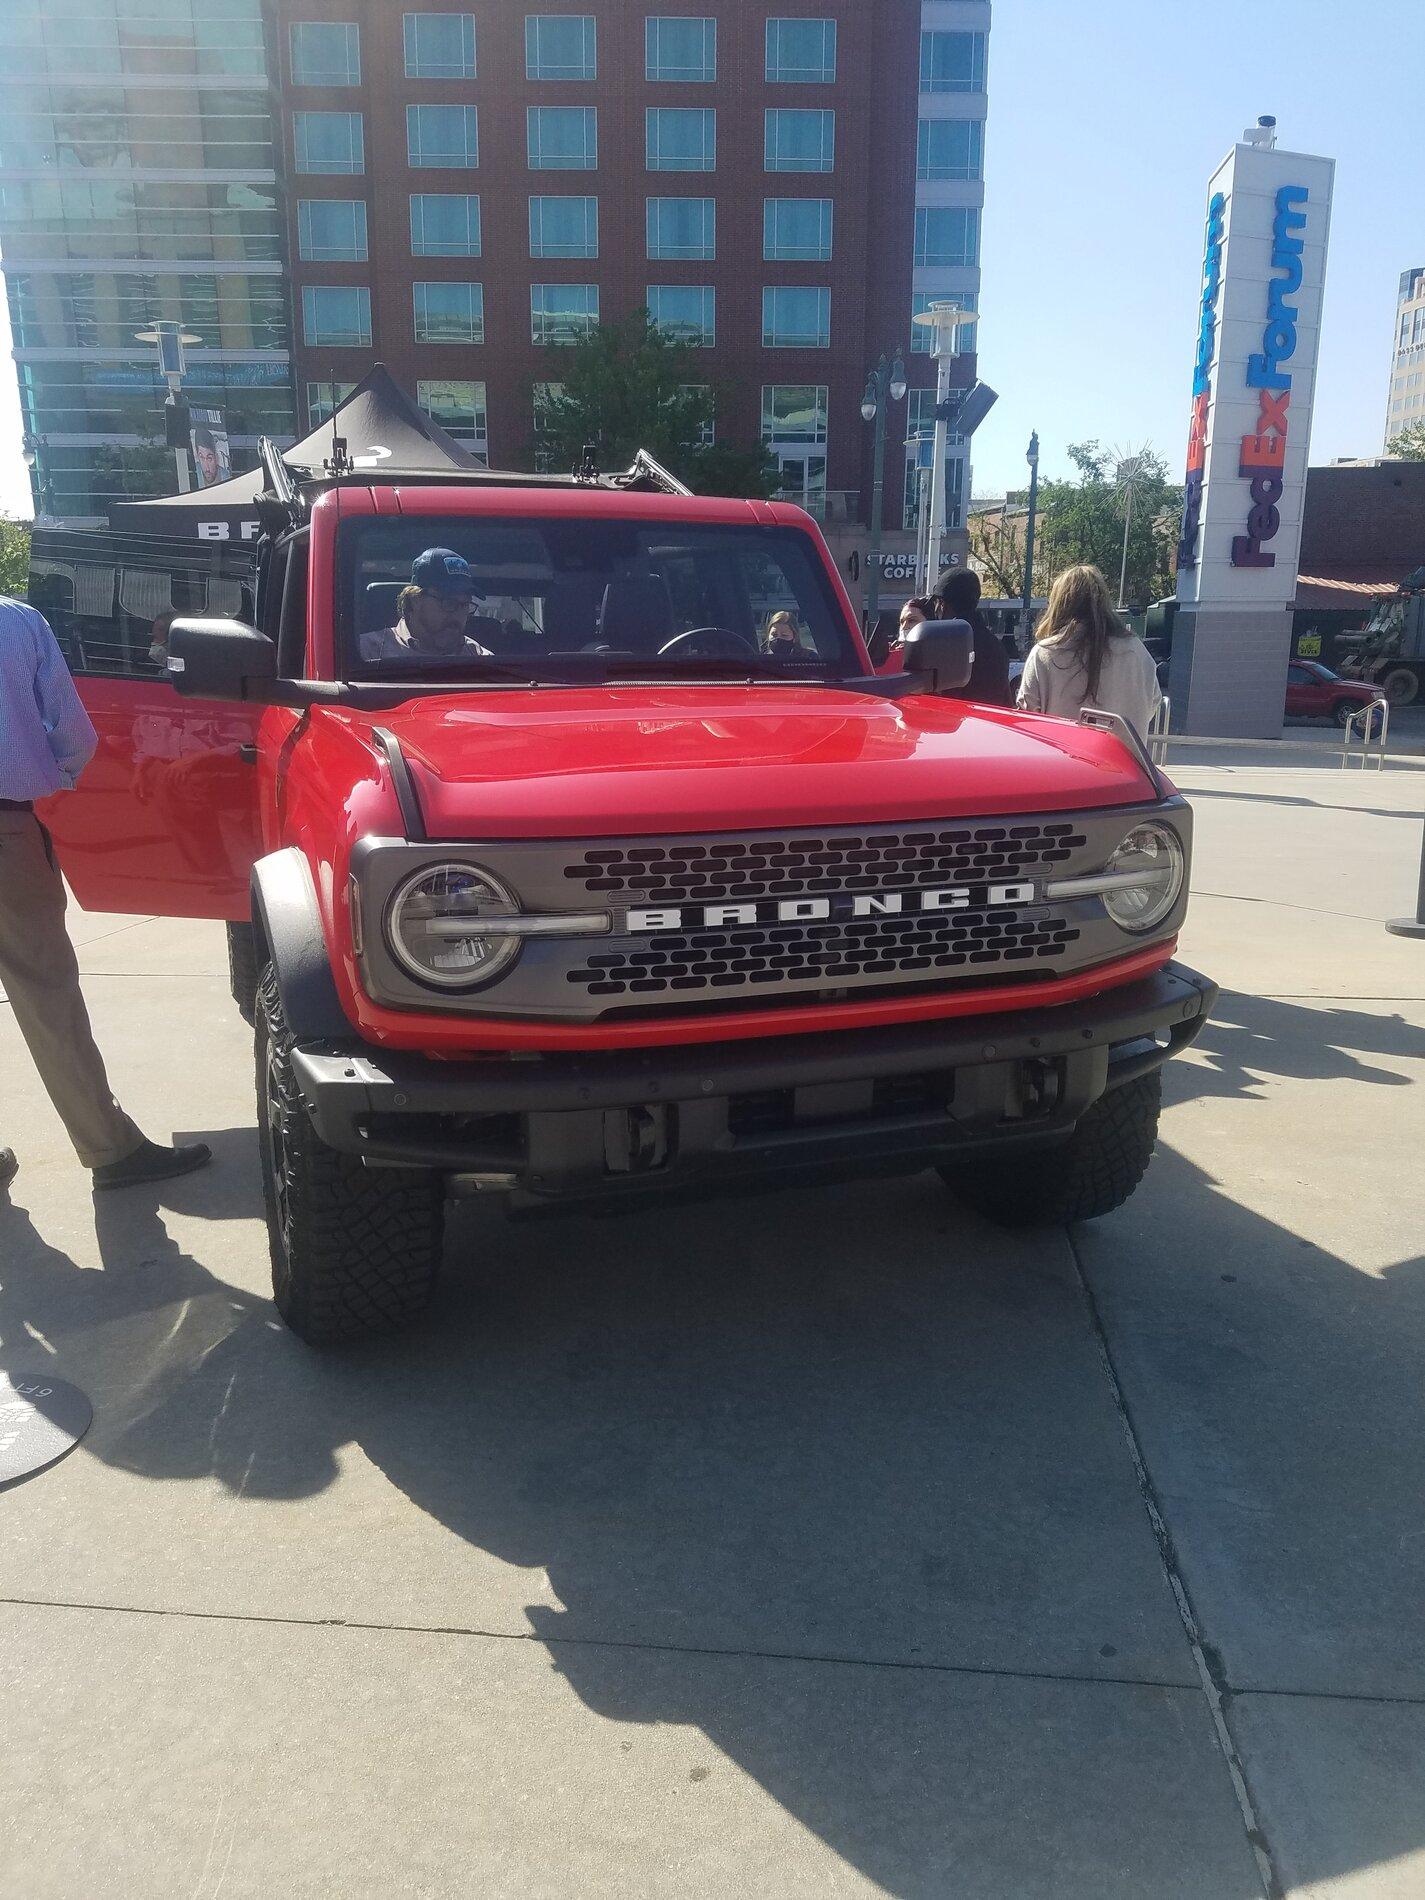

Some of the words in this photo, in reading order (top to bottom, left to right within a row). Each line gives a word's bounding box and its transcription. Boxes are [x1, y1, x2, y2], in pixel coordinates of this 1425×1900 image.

[1231, 185, 1309, 568] FedExForum
[866, 554, 960, 565] TARBKS
[626, 883, 1035, 931] BRONCO
